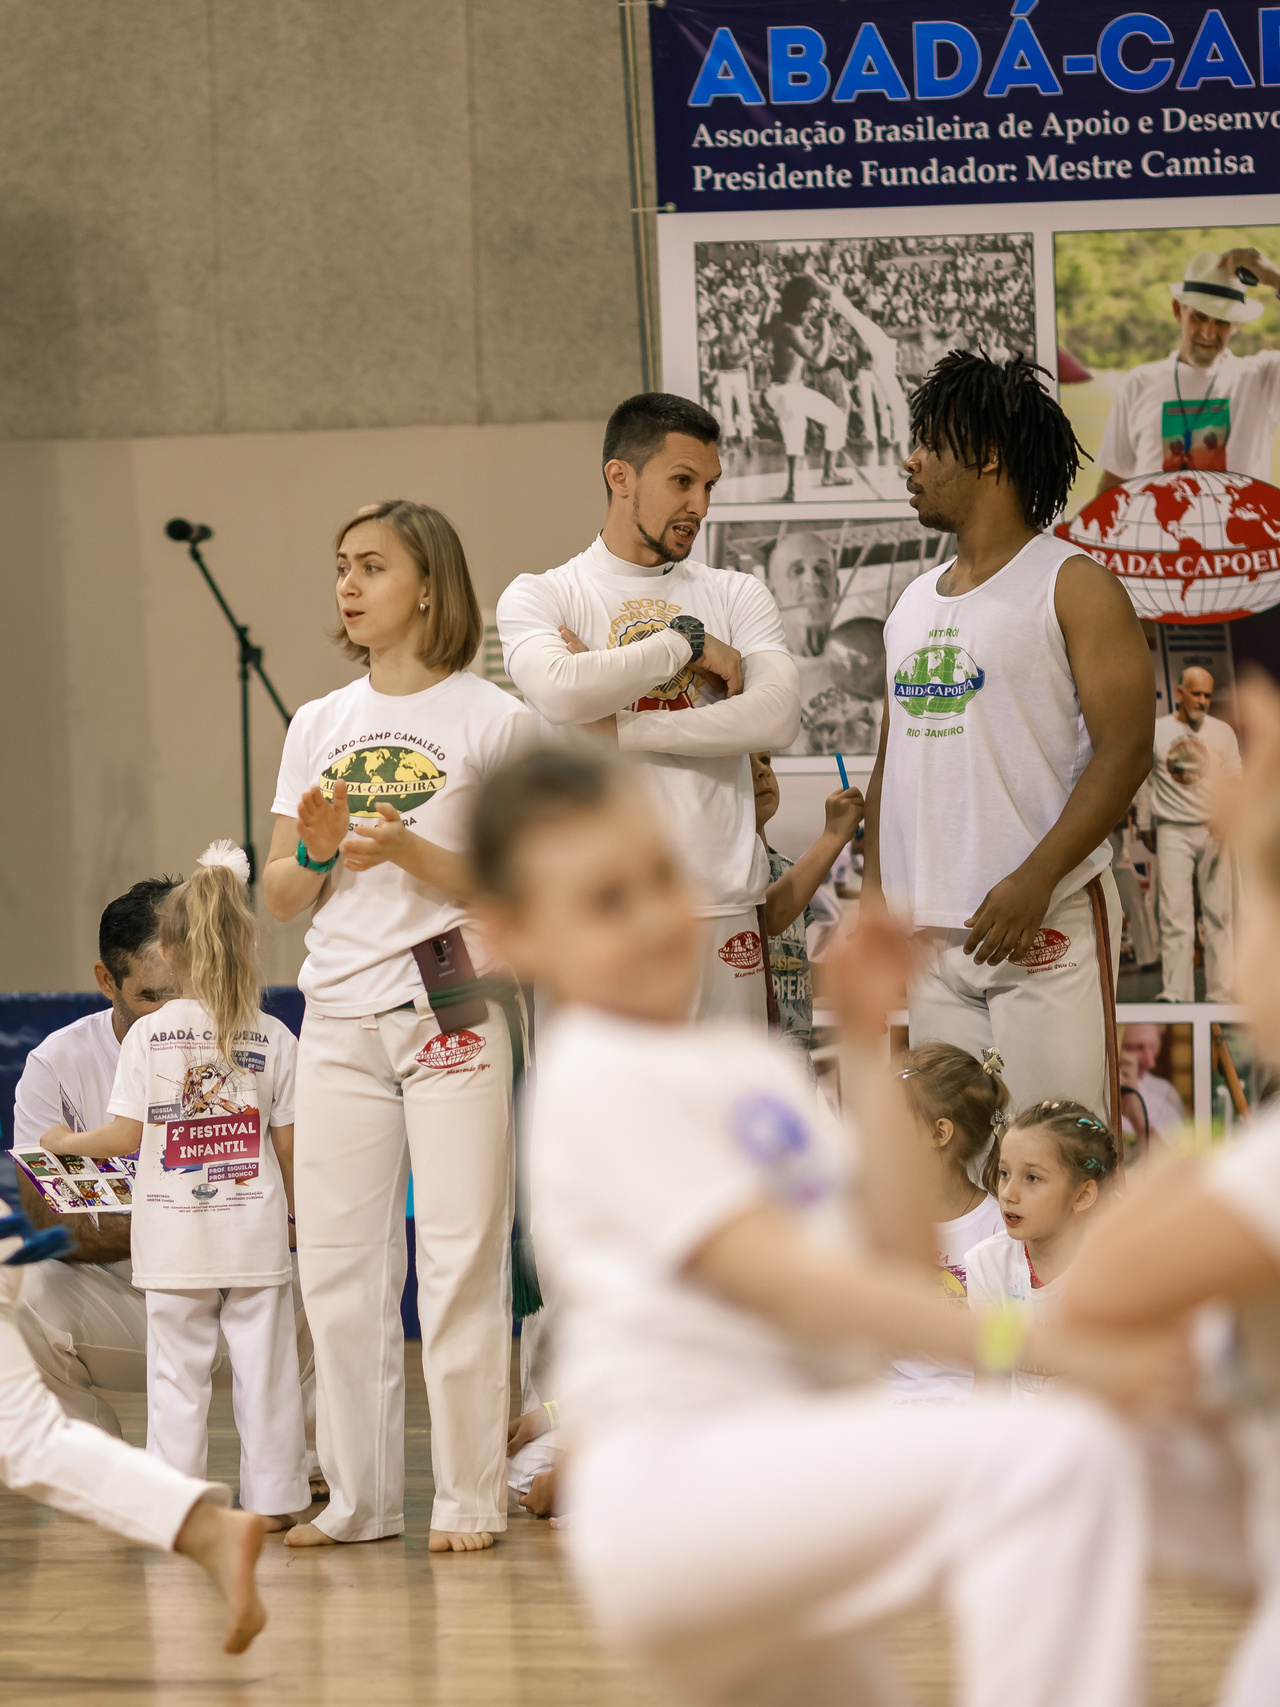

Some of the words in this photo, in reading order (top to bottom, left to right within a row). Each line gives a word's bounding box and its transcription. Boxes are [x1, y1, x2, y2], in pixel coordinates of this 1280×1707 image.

[692, 121, 846, 152] Associação
[853, 113, 991, 143] Brasileira
[998, 111, 1033, 138] de
[1040, 110, 1131, 138] Apoio
[1137, 115, 1154, 133] e
[692, 160, 853, 192] Presidente
[860, 155, 1019, 190] Fundador:
[1026, 152, 1133, 183] Mestre
[1140, 146, 1256, 178] Camisa
[1090, 548, 1280, 577] BADÁ-CAPOEI
[619, 598, 682, 615] JOGOS
[906, 727, 921, 738] RIO
[924, 726, 965, 739] JANEIRO
[327, 732, 392, 760] CAPO-CAMP
[393, 732, 446, 761] CAMALEÃO
[189, 1121, 257, 1139] FESTIVAL
[179, 1140, 247, 1159] INFANTIL
[227, 1171, 254, 1179] BRONCO
